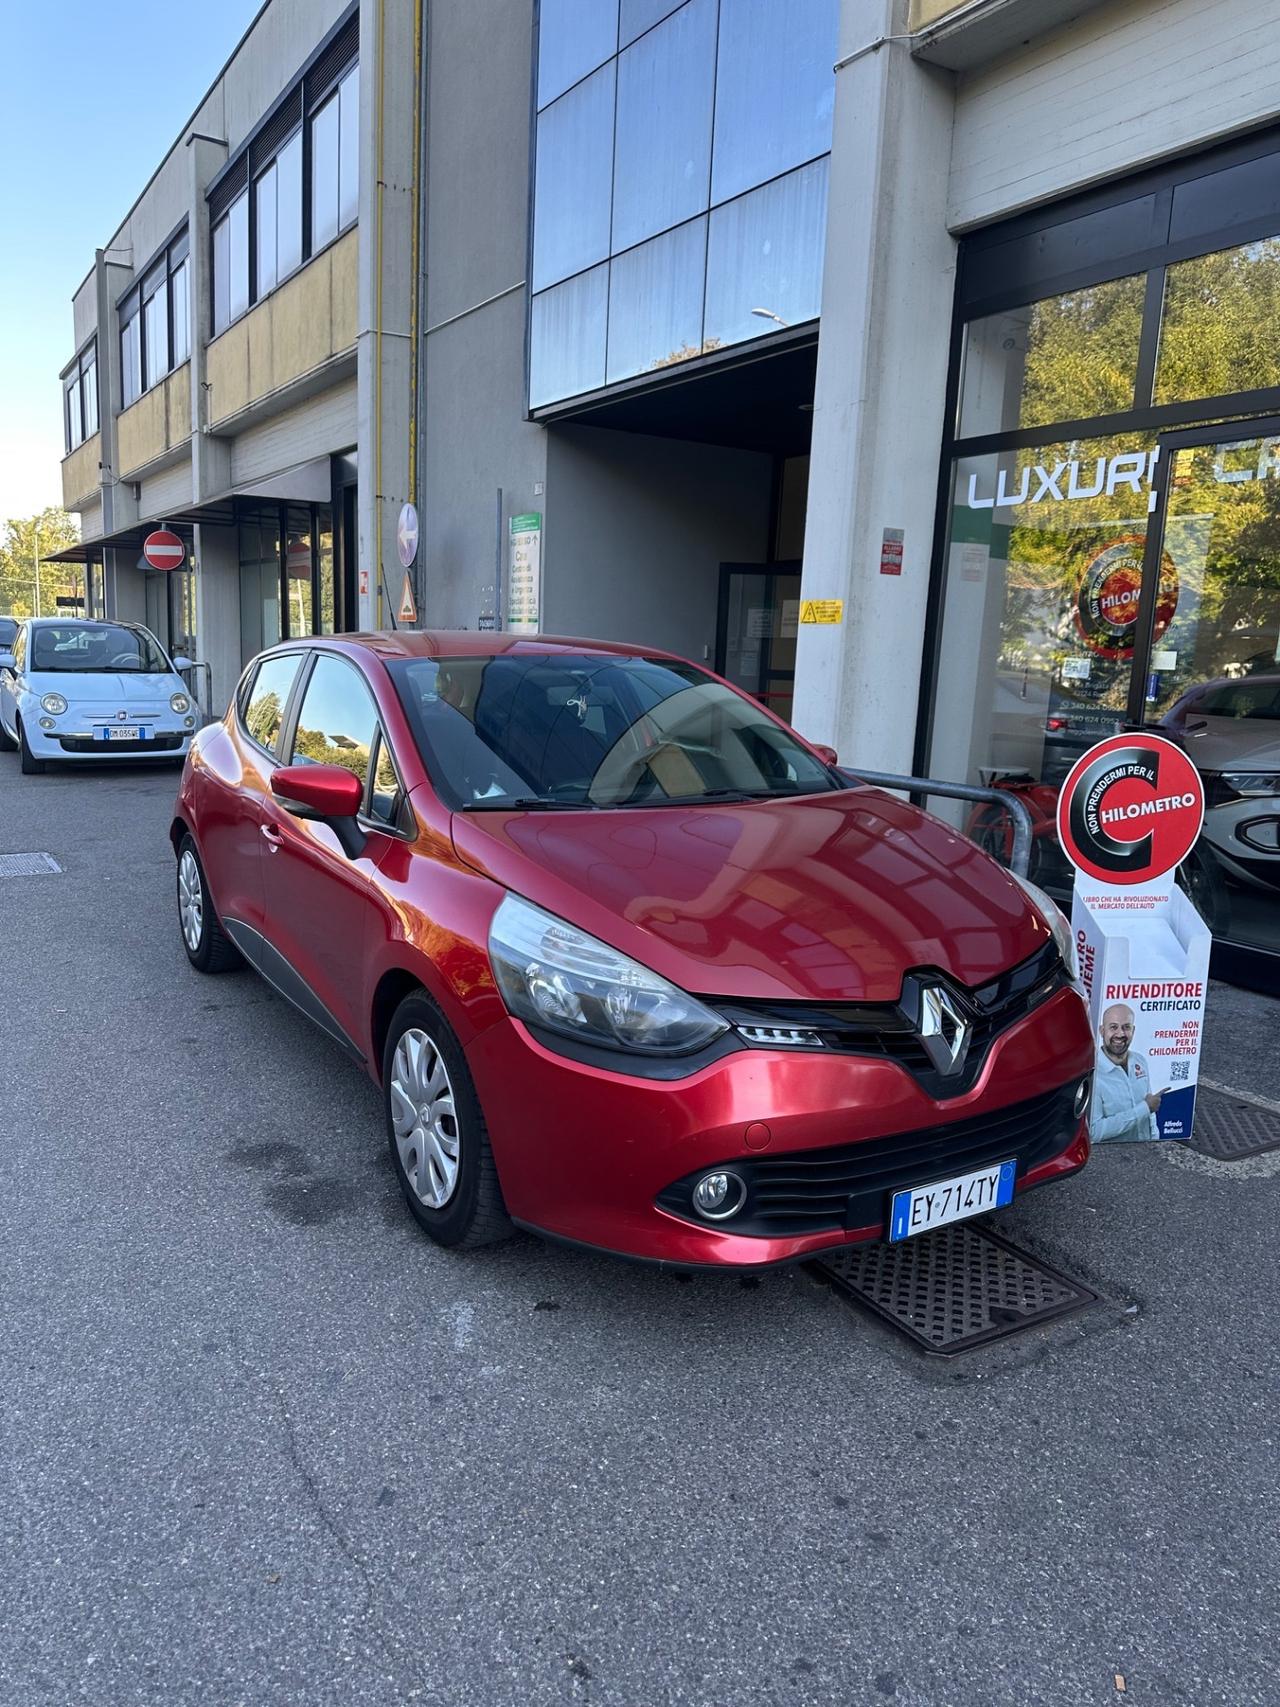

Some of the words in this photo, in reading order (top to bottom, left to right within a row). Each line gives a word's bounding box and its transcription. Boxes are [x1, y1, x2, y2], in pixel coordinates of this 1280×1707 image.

[1127, 765, 1147, 776] PER
[1147, 769, 1155, 781] IL
[1088, 767, 1127, 812] PRENDERMI
[1087, 813, 1099, 835] NON
[1105, 982, 1203, 1000] RIVENDITORE
[1140, 1000, 1201, 1012] CERTIFICATO
[1182, 1020, 1199, 1030] NON
[1154, 1029, 1199, 1039] PRENDERMI
[1175, 1038, 1190, 1047] PER
[1149, 1046, 1197, 1057] CHILOMETRO
